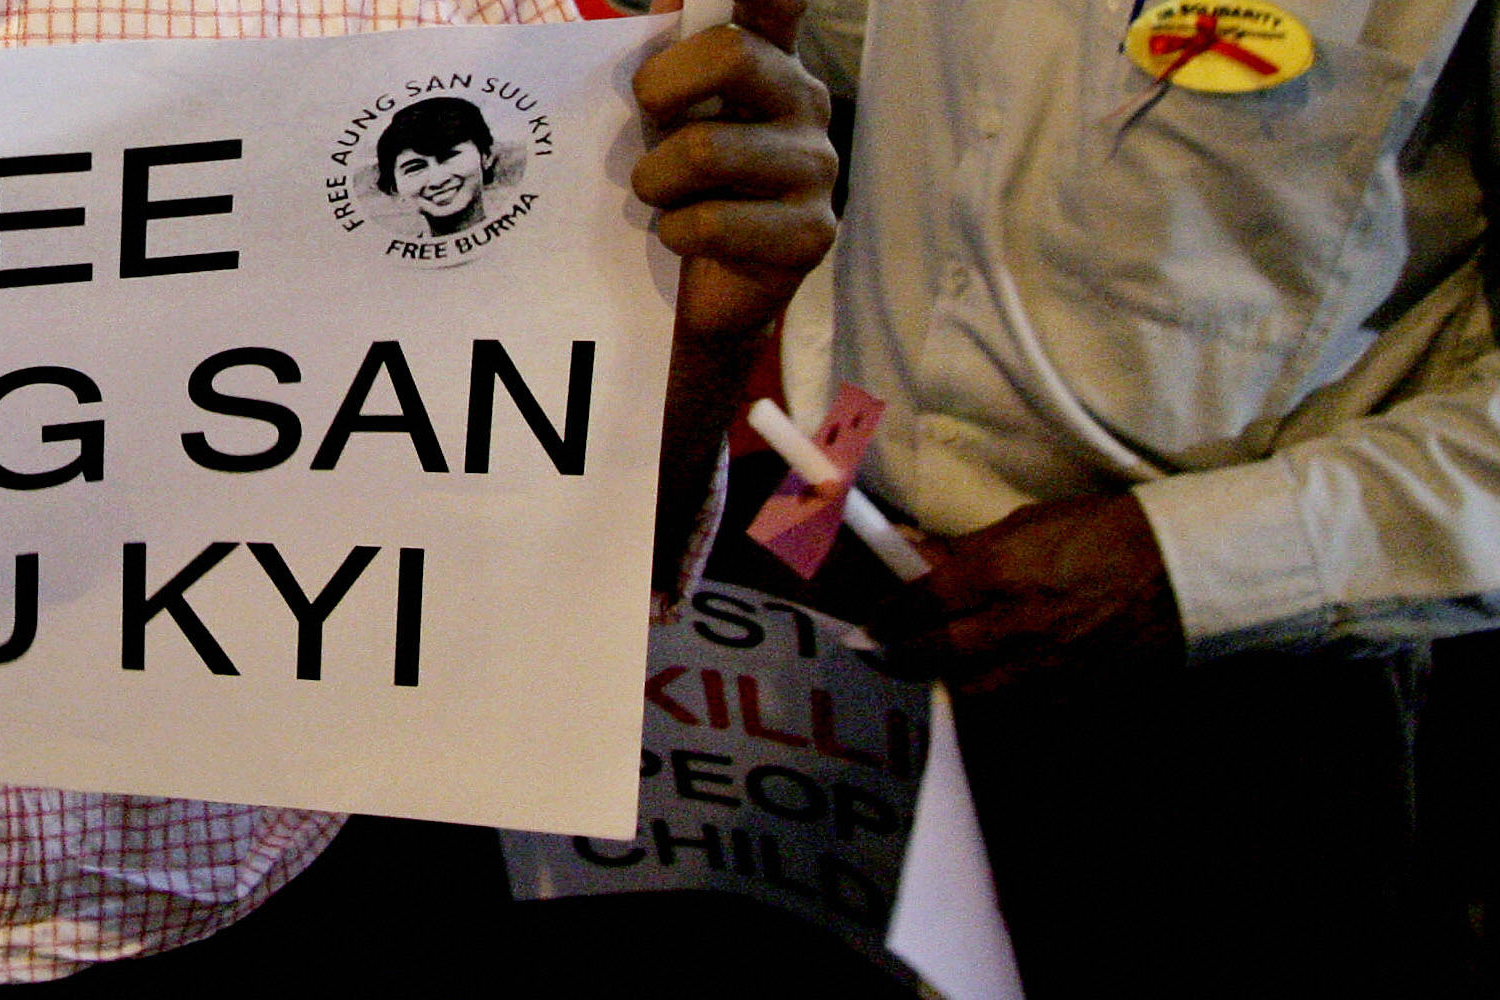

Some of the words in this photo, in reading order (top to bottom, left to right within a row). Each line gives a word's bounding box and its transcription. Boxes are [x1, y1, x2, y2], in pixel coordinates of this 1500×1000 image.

[405, 73, 473, 97] SAN
[481, 77, 538, 112] SUU
[331, 93, 396, 167] AUNG
[528, 115, 553, 157] KYI
[326, 175, 365, 233] FREE
[385, 239, 448, 260] FREE
[454, 191, 539, 255] BURMA
[181, 339, 595, 476] SAN
[122, 542, 425, 687] KYI
